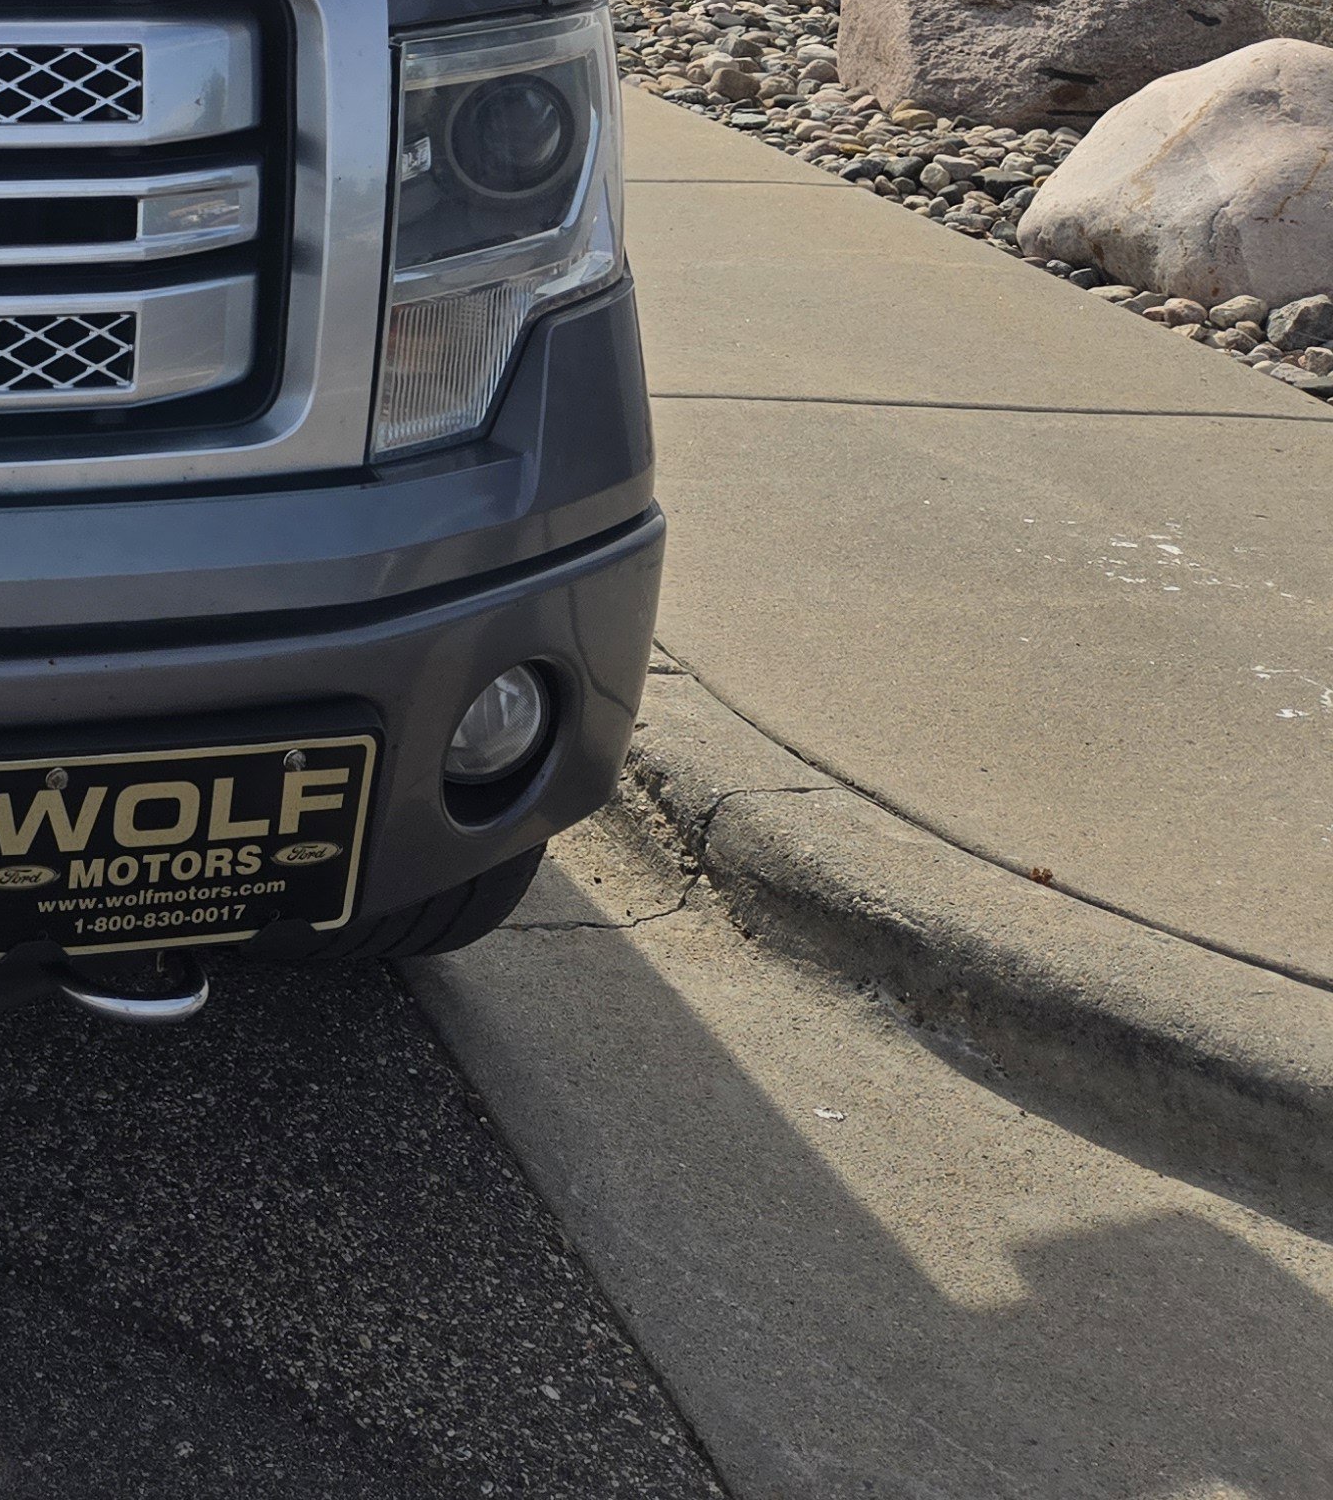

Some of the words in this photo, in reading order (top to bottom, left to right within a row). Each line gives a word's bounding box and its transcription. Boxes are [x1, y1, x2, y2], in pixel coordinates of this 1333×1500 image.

[68, 845, 263, 890] MOTORS
[286, 846, 326, 861] Ford
[37, 879, 287, 913] www.wolfmotors.com
[74, 904, 247, 934] 1-800-830-0017
